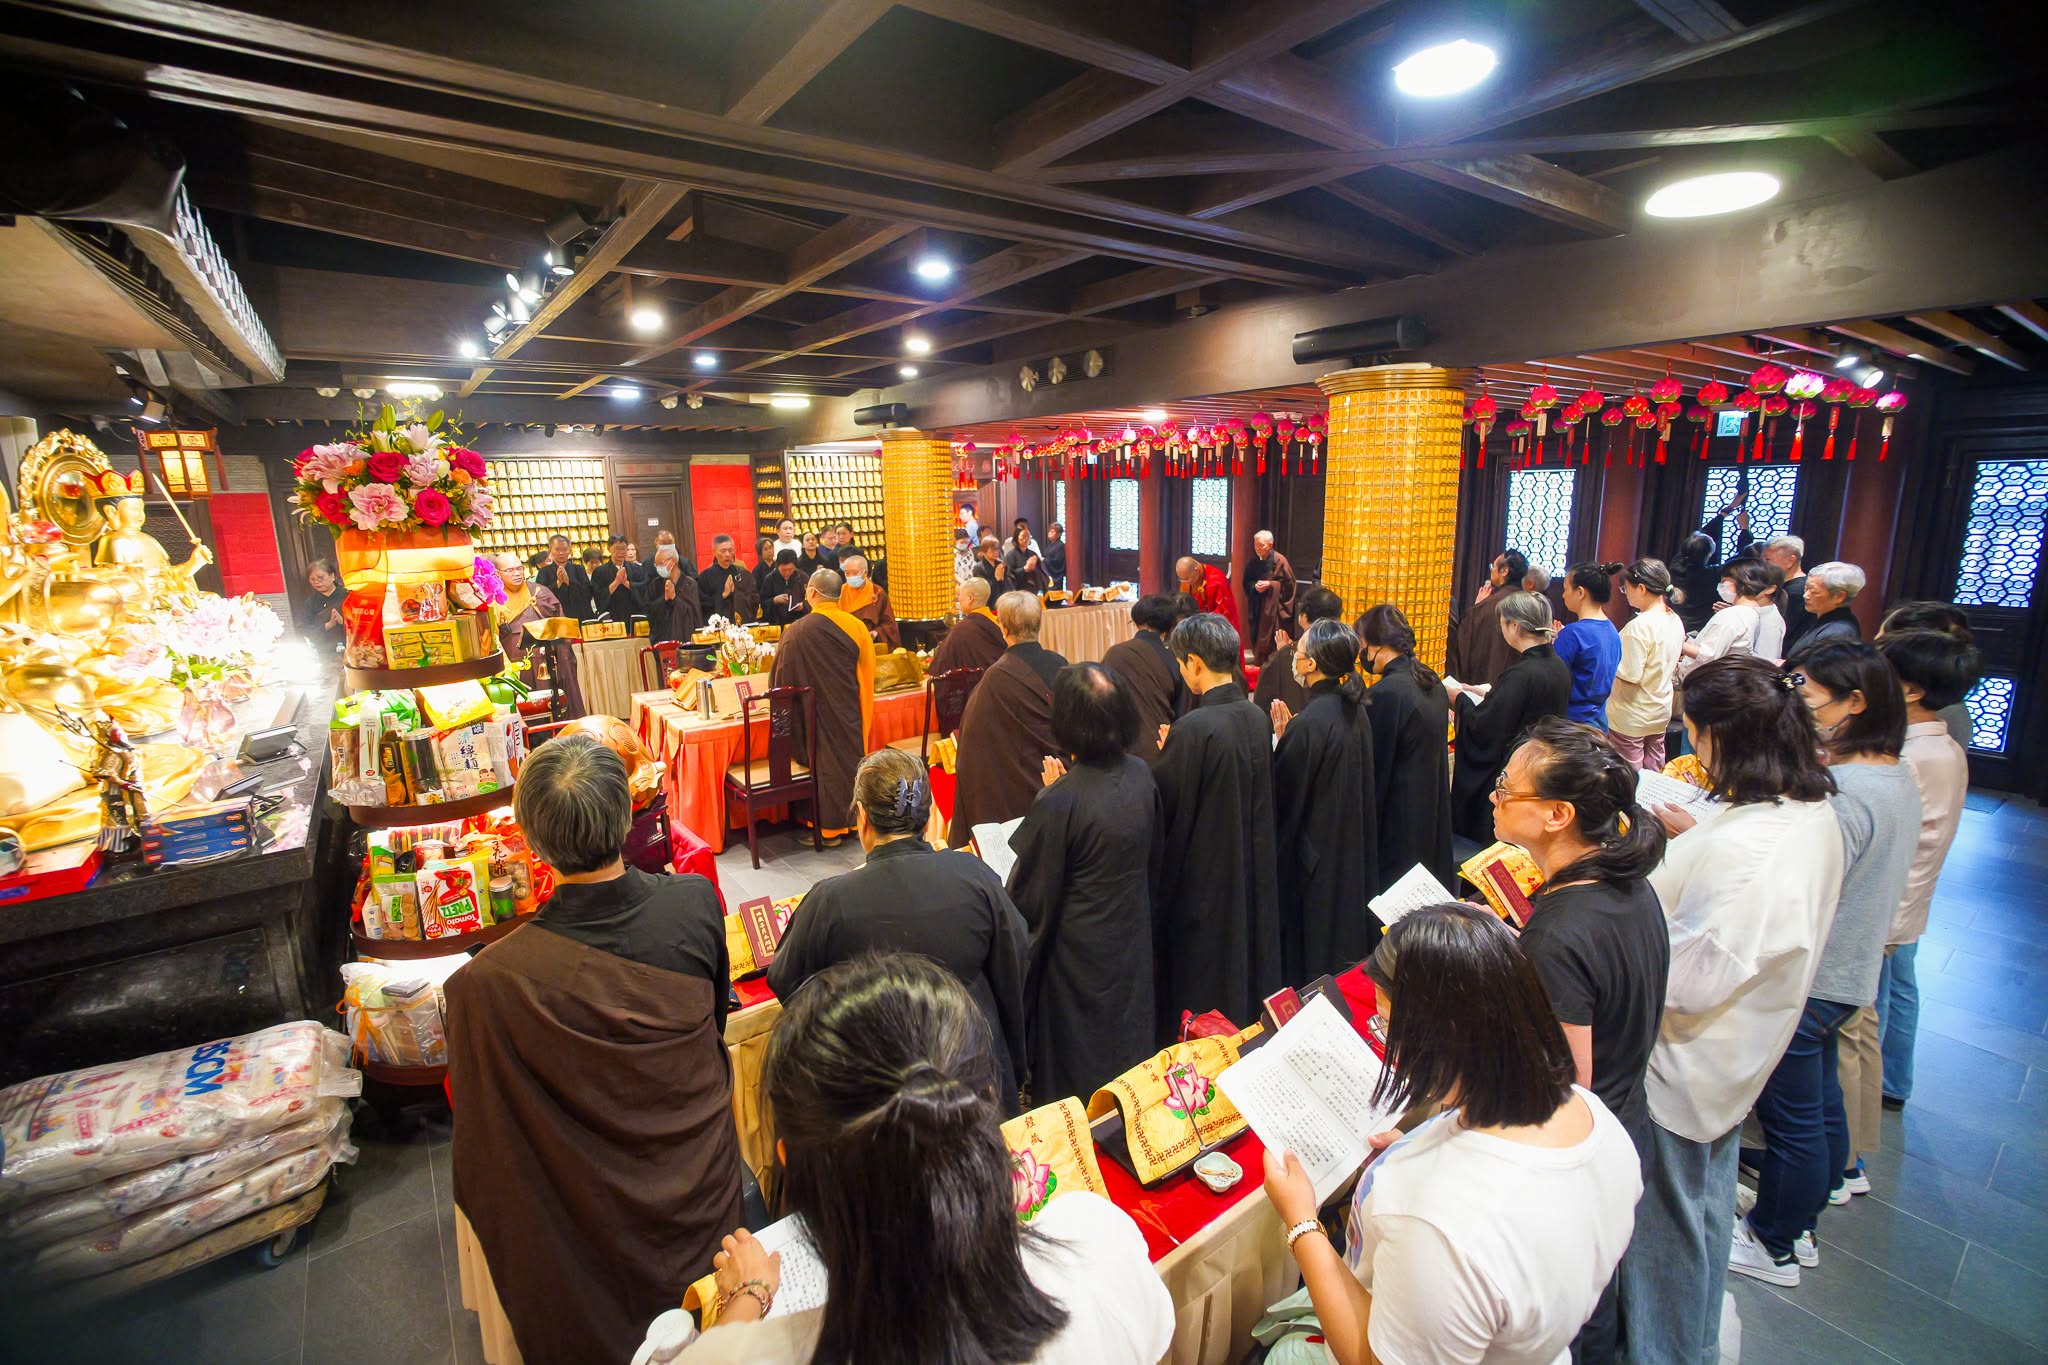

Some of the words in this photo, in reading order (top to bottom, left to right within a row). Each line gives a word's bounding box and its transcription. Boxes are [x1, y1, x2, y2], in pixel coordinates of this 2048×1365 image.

[513, 720, 522, 746] EDO
[441, 898, 473, 917] PRETZ
[446, 914, 478, 925] Tomato
[185, 1041, 231, 1096] BSCM
